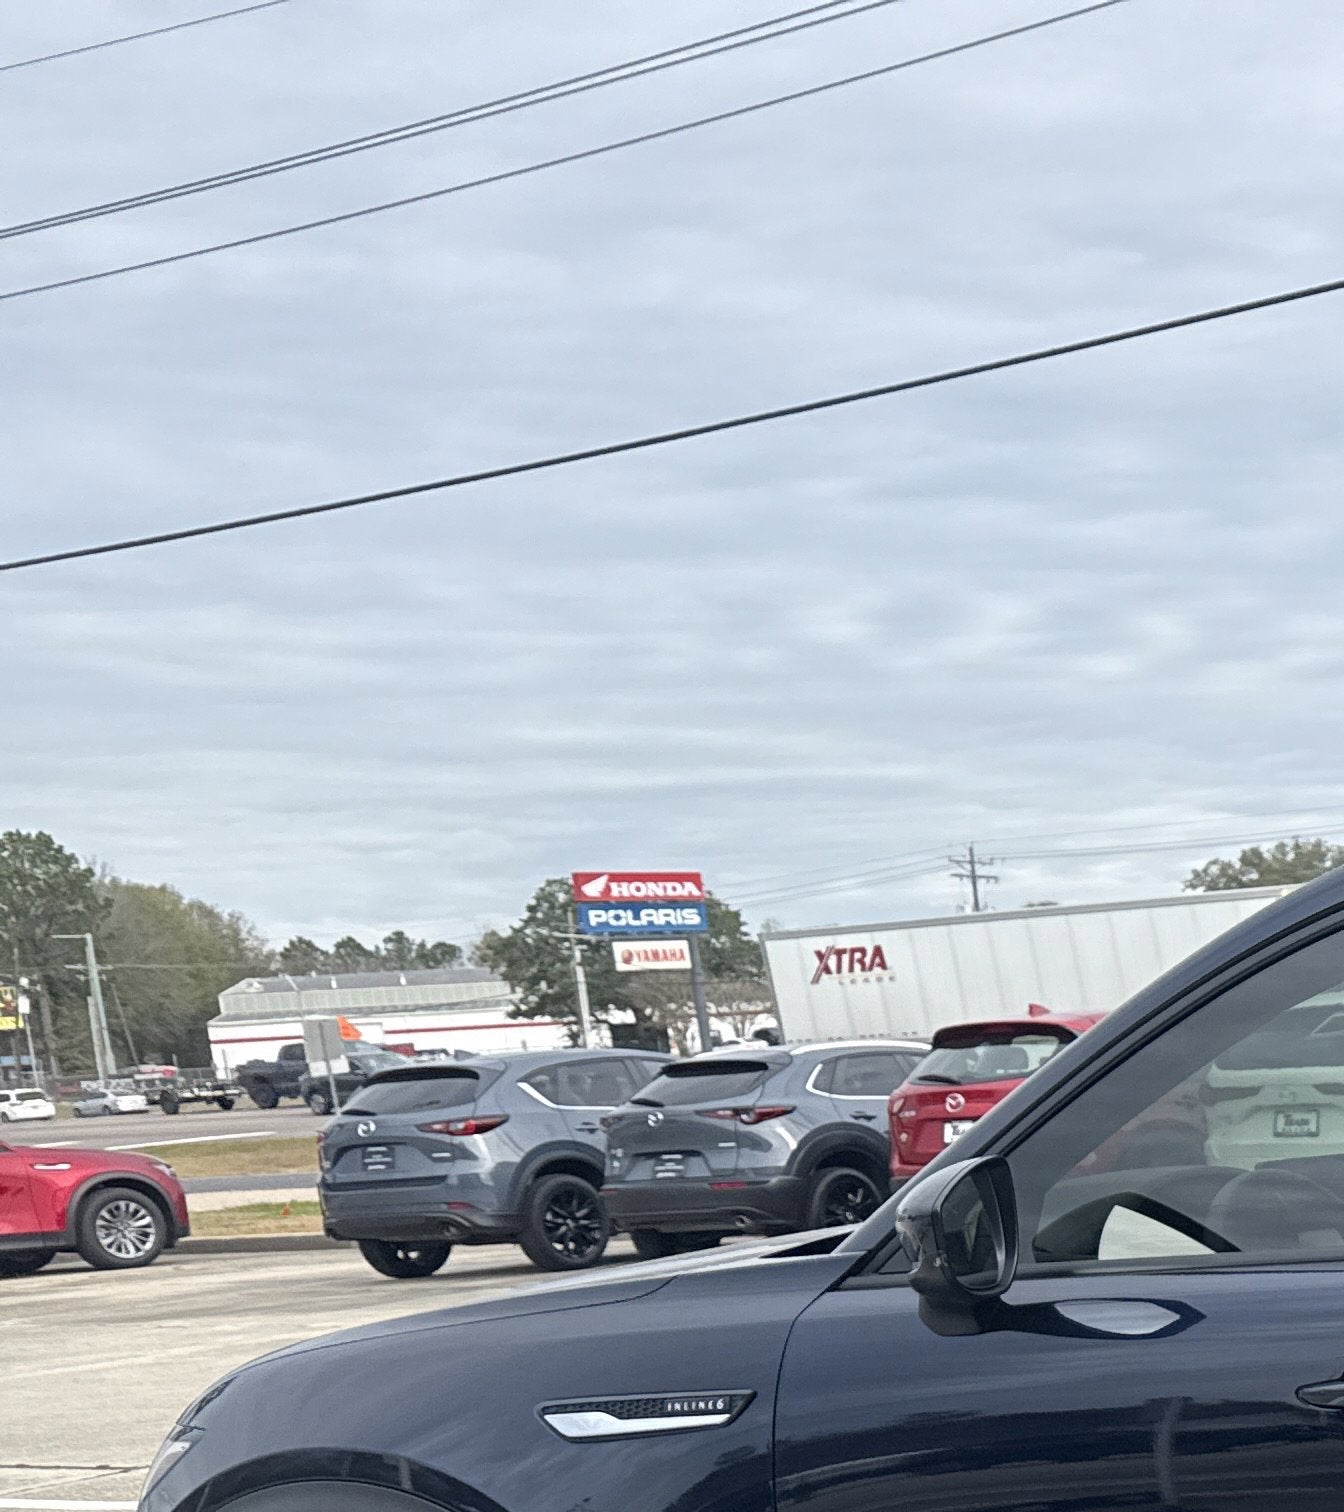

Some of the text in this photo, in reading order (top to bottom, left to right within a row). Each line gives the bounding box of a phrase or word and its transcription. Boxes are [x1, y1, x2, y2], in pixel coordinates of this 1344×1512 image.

[608, 882, 701, 897] HONDA
[588, 908, 701, 927] POLARIS
[634, 948, 686, 962] YAMAHA
[810, 944, 889, 985] XTRA
